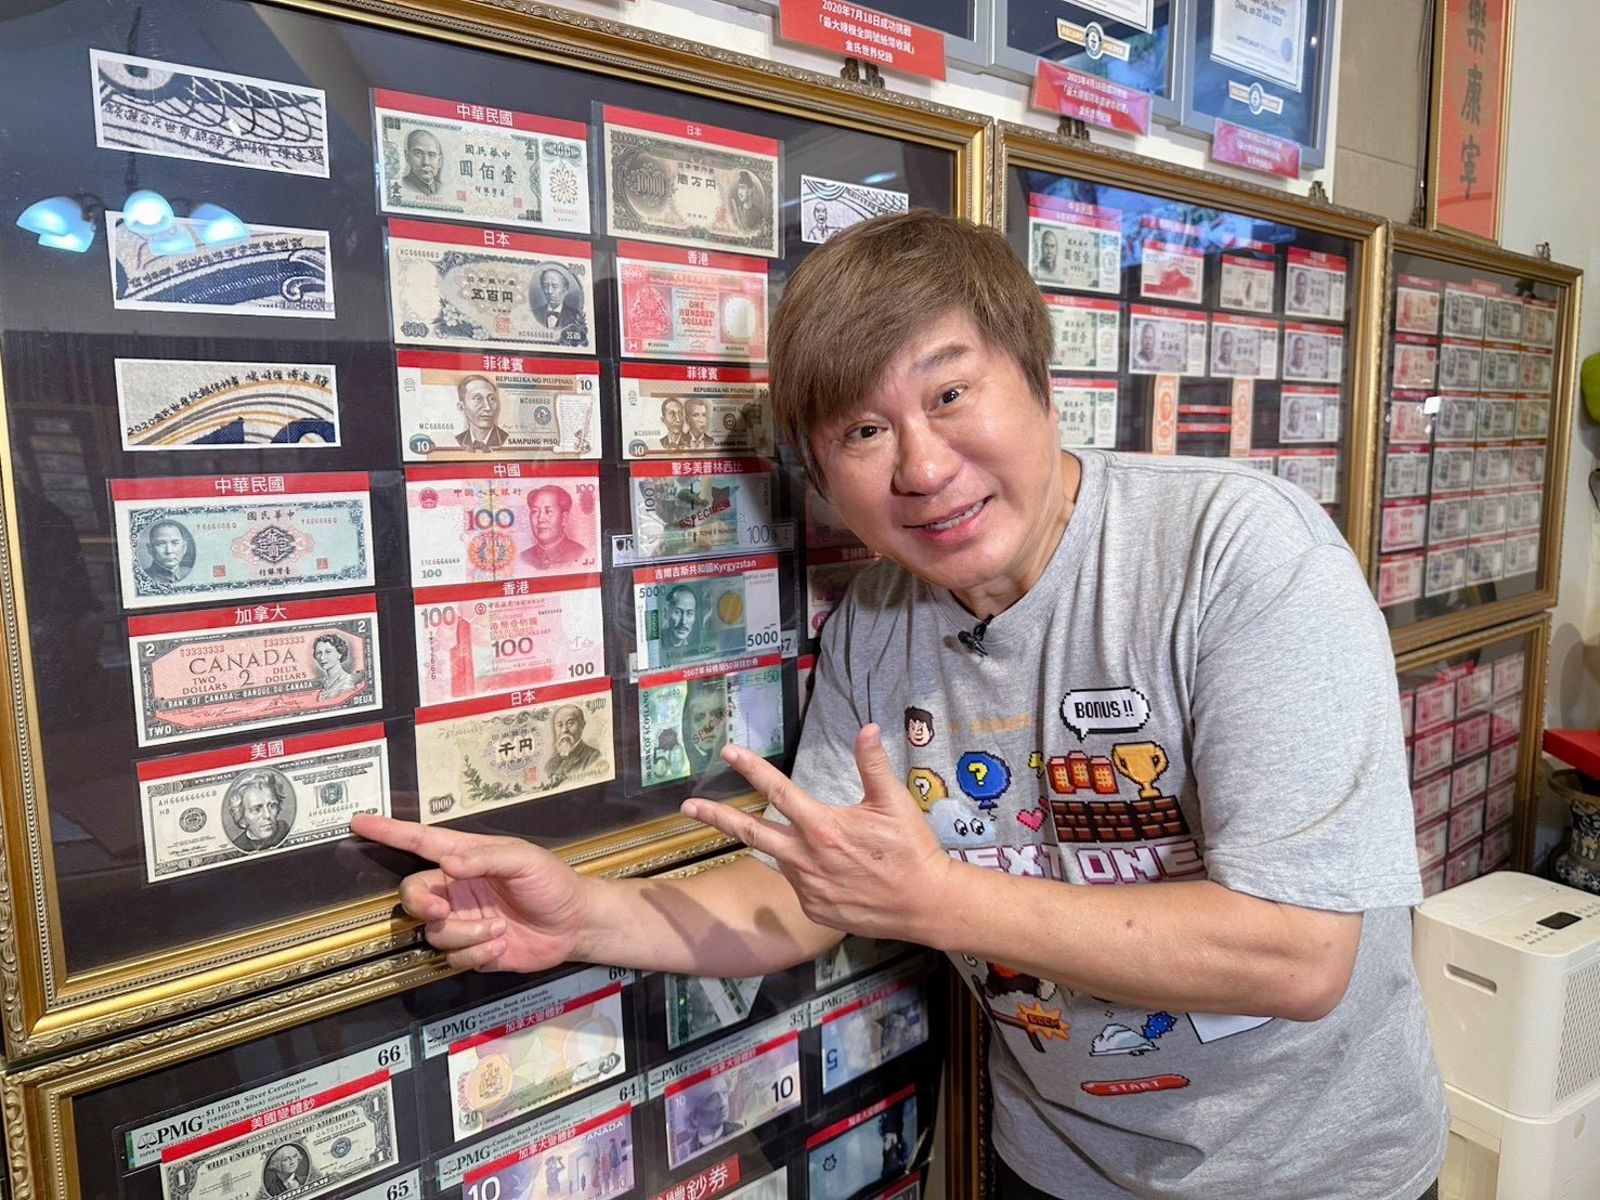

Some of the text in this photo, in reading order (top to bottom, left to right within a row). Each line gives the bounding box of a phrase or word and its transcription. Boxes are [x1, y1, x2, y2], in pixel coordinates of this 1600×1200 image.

[845, 40, 894, 64] 金氏世界紀錄
[457, 102, 514, 127] 中華民國
[686, 125, 703, 137] 日本
[483, 230, 510, 246] 日本
[687, 250, 710, 266] 香港
[471, 288, 514, 304] 五百円
[689, 300, 705, 310] ONE
[403, 324, 427, 338] 500
[483, 356, 525, 373] 菲律賓
[686, 366, 719, 381] 菲律賓
[580, 379, 593, 391] 10
[759, 389, 769, 399] 10
[415, 441, 430, 454] 10
[507, 437, 559, 446] SAMPUNG PISO
[633, 445, 645, 455] 10
[493, 463, 521, 478] 中國
[214, 475, 286, 495] 中華民國
[575, 483, 595, 495] 100
[645, 487, 657, 513] 100
[466, 507, 516, 532] 100
[747, 524, 770, 544] 100
[422, 569, 442, 579] 100
[502, 580, 529, 596] 香港
[235, 604, 288, 625] 加拿大
[420, 606, 456, 629] 100
[357, 620, 367, 633] 2
[747, 630, 779, 648] 5000
[145, 644, 156, 657] 2
[491, 637, 534, 659] 100
[189, 648, 297, 675] CANADA
[273, 665, 299, 675] DEUX
[568, 661, 595, 678] 100
[193, 676, 217, 686] TWO
[239, 669, 255, 688] 2
[265, 672, 308, 684] DOLLARS
[168, 699, 190, 710] BANK
[191, 697, 201, 705] OF
[204, 692, 234, 704] CANADA
[285, 681, 313, 692] CANADA
[182, 682, 228, 695] DOLLARS
[352, 694, 374, 705] DEUX
[510, 690, 537, 707] 日本
[1075, 700, 1122, 719] BONUS
[147, 724, 172, 737] TWO
[692, 701, 738, 746] SPECIMEN
[250, 739, 286, 761] 美國
[499, 737, 533, 757] 千円
[290, 831, 334, 845] TWENTY
[1076, 839, 1205, 885] ONE
[789, 1009, 804, 1028] 35
[442, 1016, 477, 1040] PMG
[377, 1045, 402, 1067] 66
[602, 1056, 616, 1070] 20
[661, 1060, 689, 1081] PMG
[619, 1084, 637, 1102] 64
[771, 1075, 794, 1104] 10
[1108, 1078, 1160, 1093] START
[675, 1096, 686, 1107] 10
[157, 1116, 203, 1145] PMG
[218, 1099, 241, 1112] 1957B
[243, 1090, 266, 1103] Silver
[267, 1077, 307, 1095] Certificate
[206, 1109, 357, 1171] THE UNITED STATES OF AMERICA
[580, 1120, 624, 1145] CANADA
[455, 1145, 491, 1170] PMG
[386, 1180, 410, 1200] 65
[467, 1175, 501, 1200] 10
[656, 1163, 729, 1200] 體鈔券
